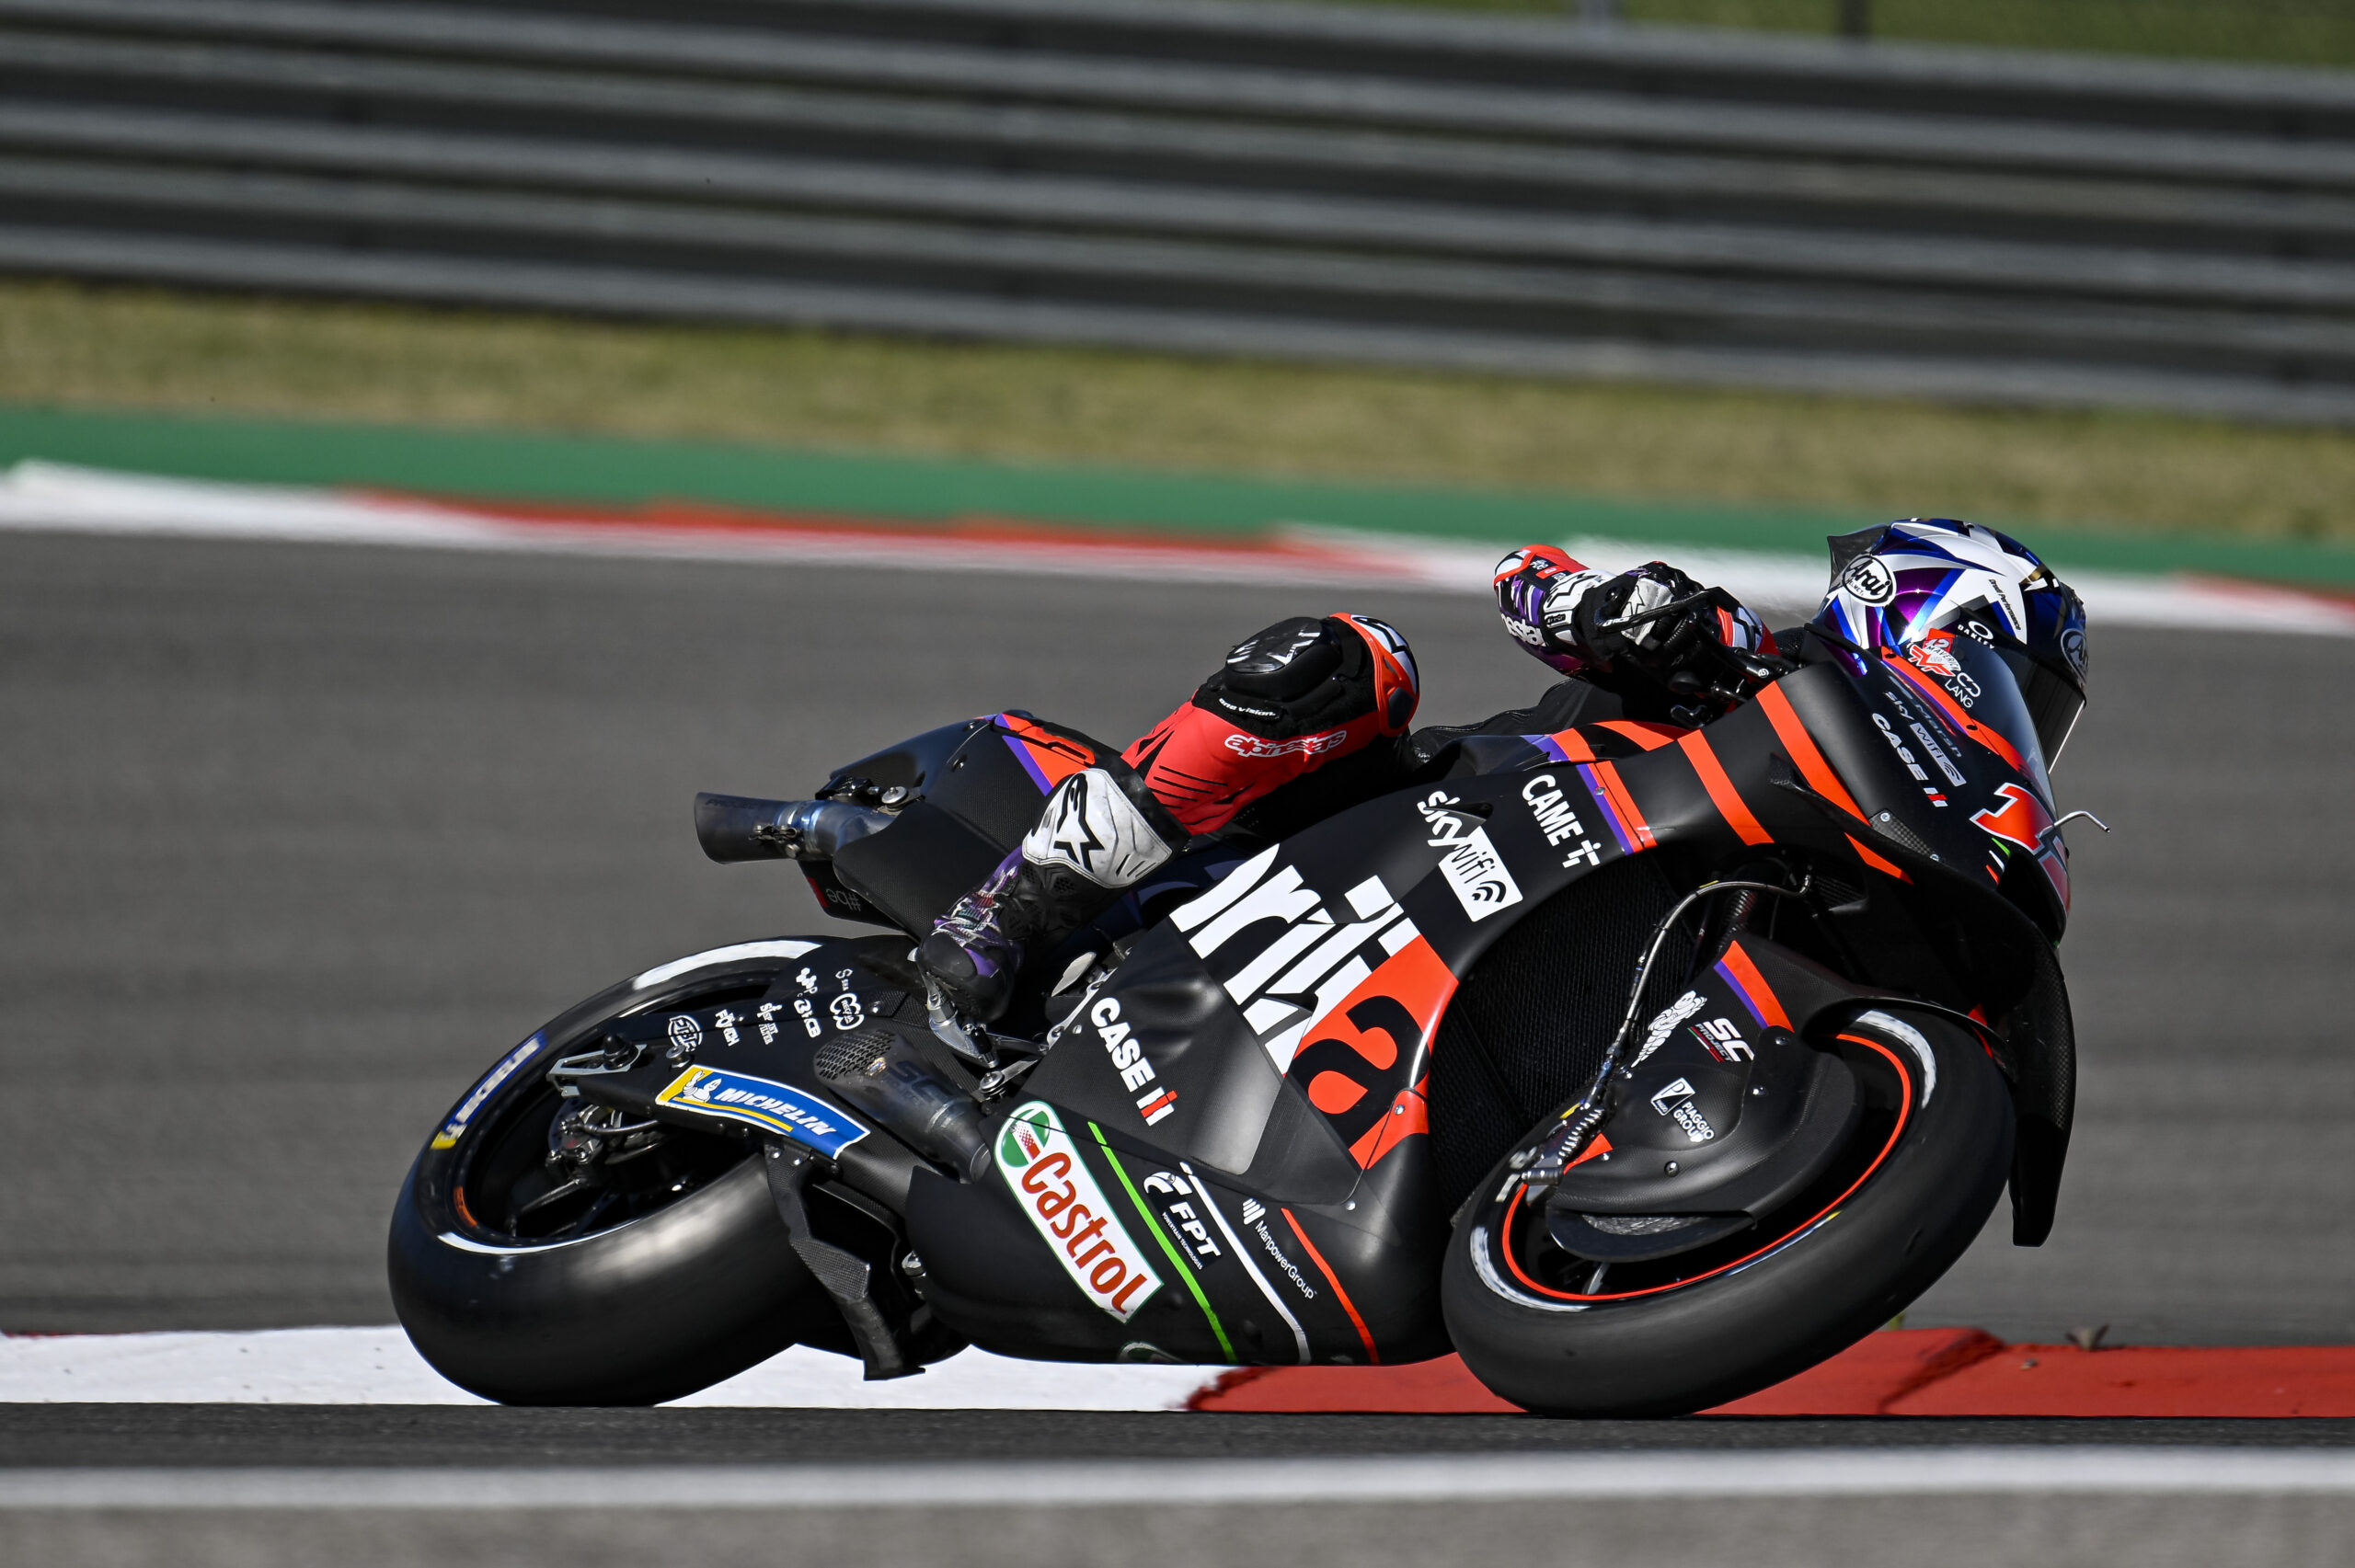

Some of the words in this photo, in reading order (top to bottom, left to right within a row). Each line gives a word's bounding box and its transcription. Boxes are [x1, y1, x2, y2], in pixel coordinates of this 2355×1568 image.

[1848, 559, 1891, 596] Arai
[1885, 691, 1914, 721] sky
[1945, 679, 1974, 709] LANG
[1872, 713, 1929, 782] CASE
[1418, 791, 1468, 847] sky
[1522, 774, 1584, 847] CAME
[1091, 997, 1156, 1093] CASE
[1694, 1023, 1732, 1062] PROJECT
[1703, 1017, 1755, 1062] SC
[714, 1088, 838, 1137] MICHELIN
[1682, 1101, 1716, 1141] PIAGGIO
[1021, 1151, 1148, 1315] Castrol
[1168, 1200, 1222, 1259] FPT
[1255, 1220, 1315, 1300] ManpowerGroup
